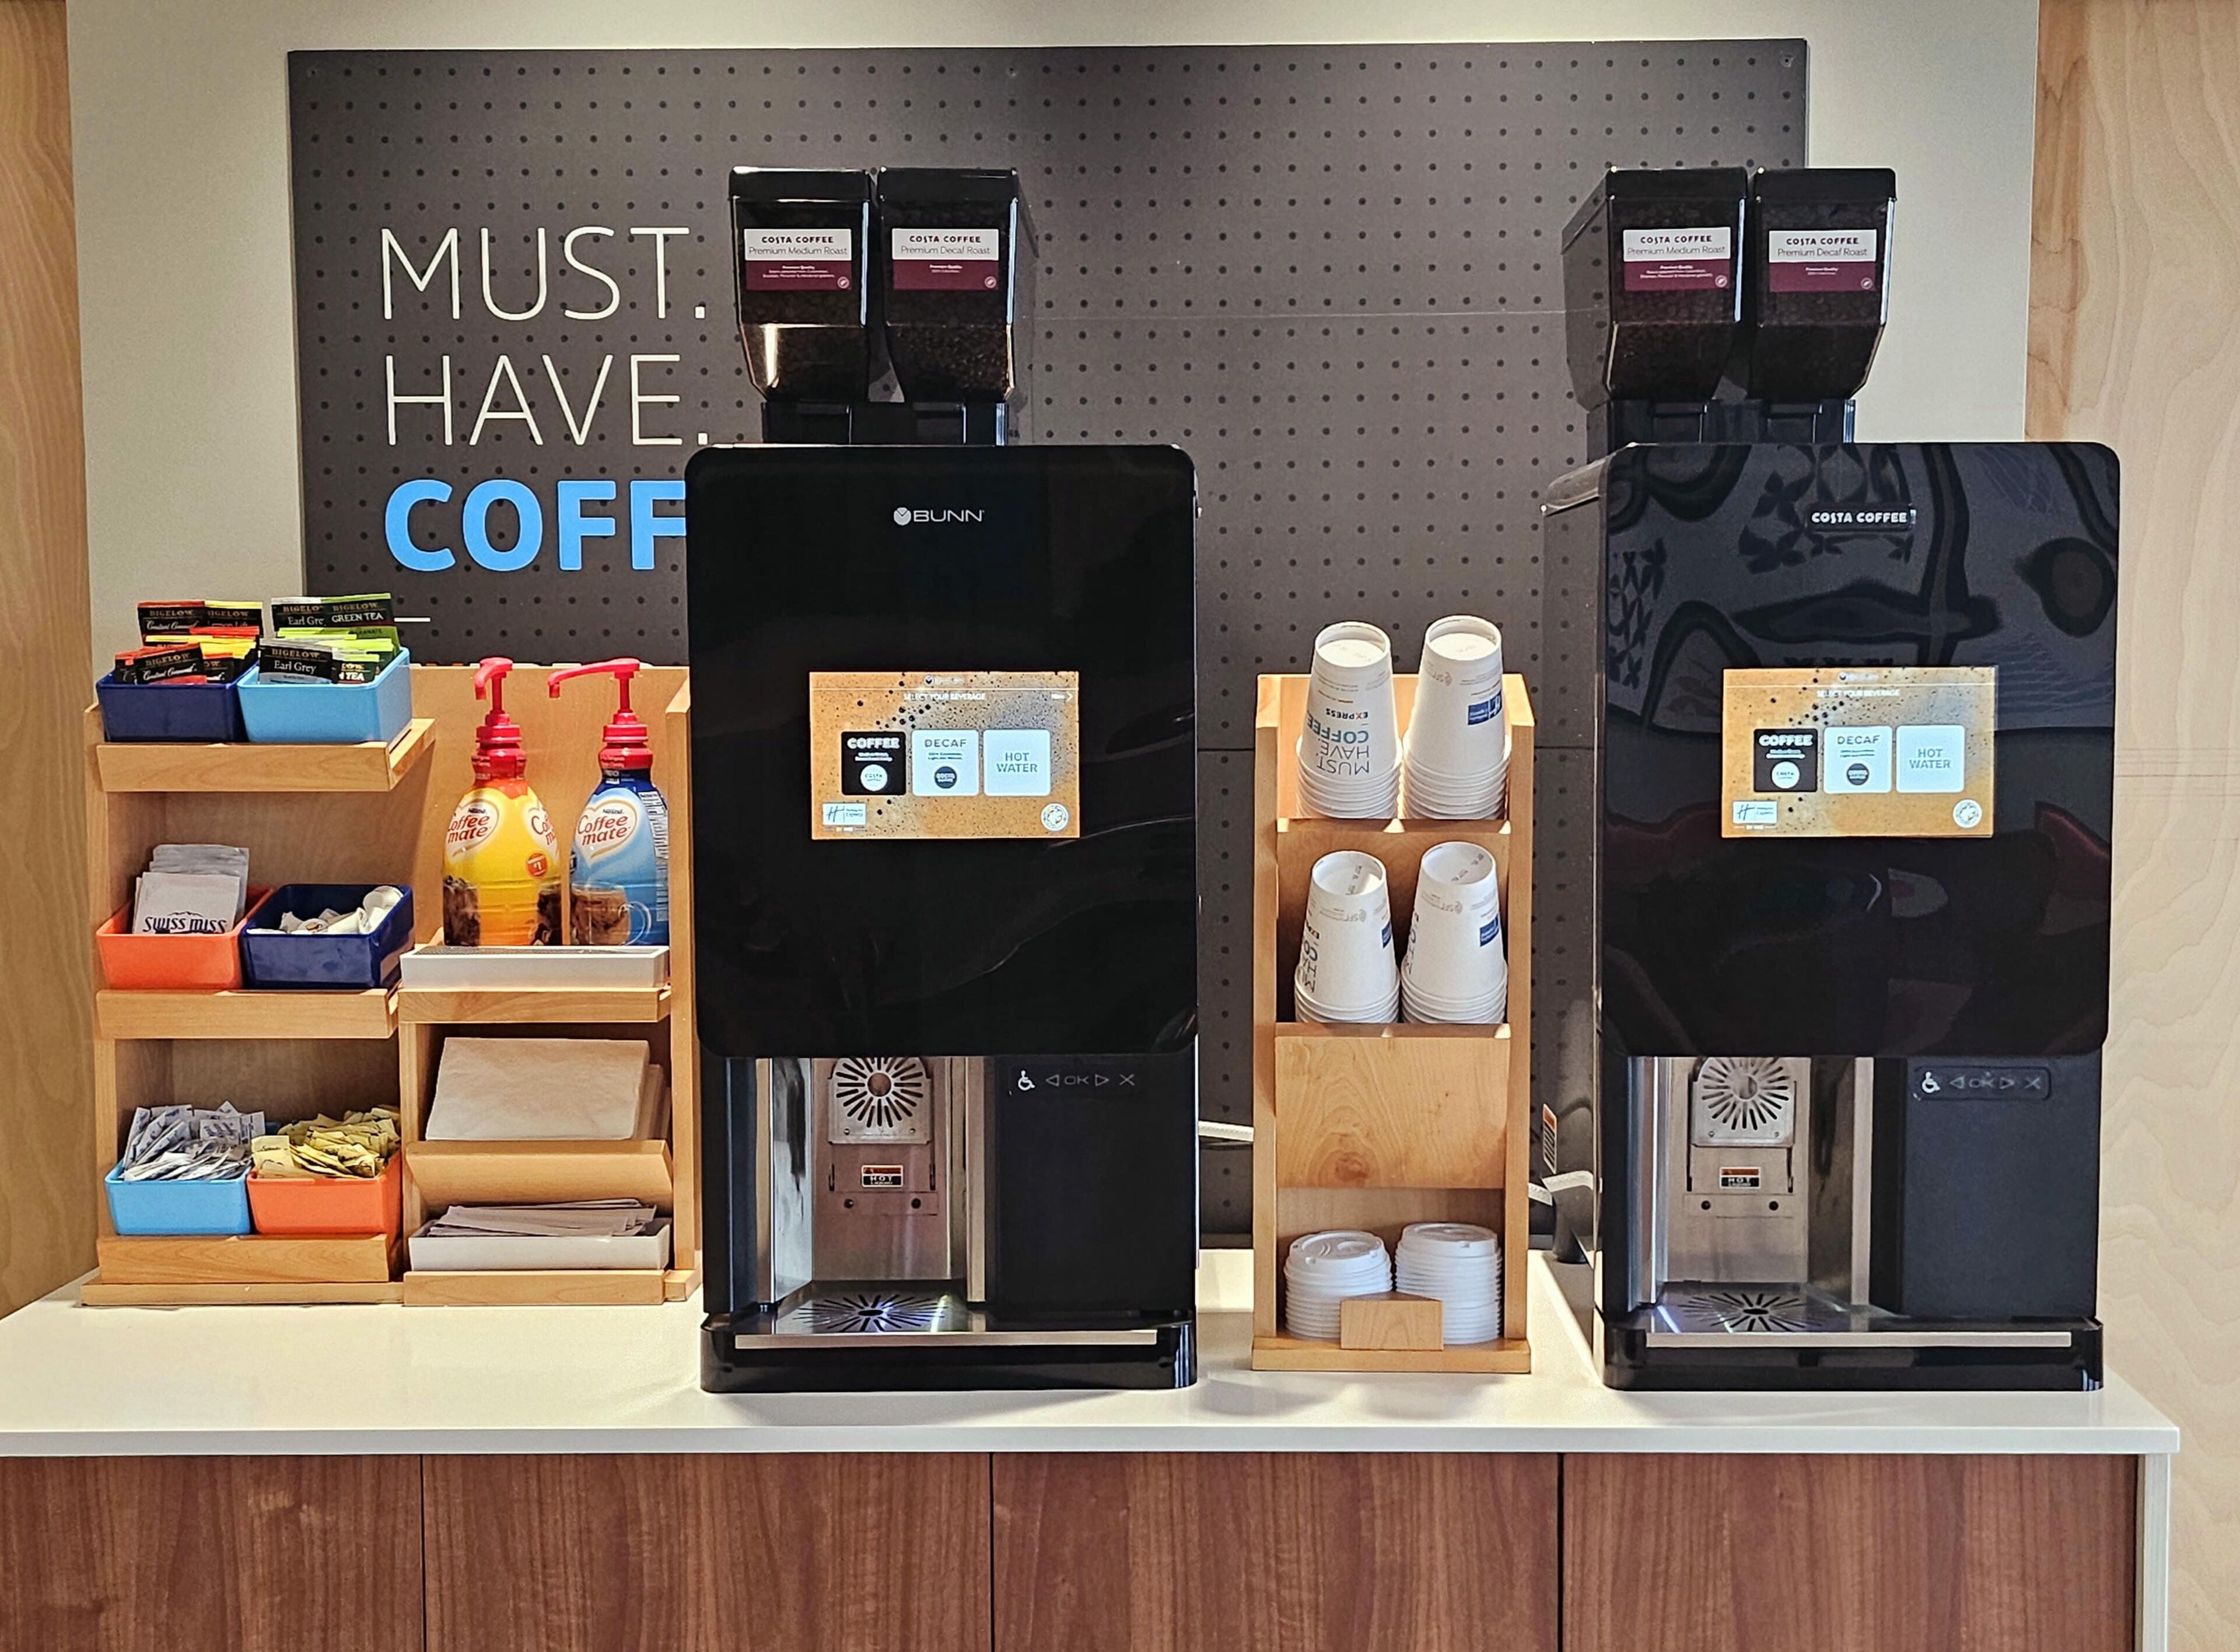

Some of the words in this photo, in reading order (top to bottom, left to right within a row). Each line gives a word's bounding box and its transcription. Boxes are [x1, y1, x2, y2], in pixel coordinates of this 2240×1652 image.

[1674, 235, 1712, 243] COFFEE
[749, 246, 786, 255] Premium
[788, 246, 822, 255] Medium
[824, 246, 848, 255] Roast
[901, 246, 939, 254] Premium
[967, 246, 991, 255] Roast
[1628, 247, 1664, 256] Premium
[1667, 247, 1700, 255] Medium
[1702, 246, 1725, 254] Roast
[1778, 249, 1815, 257] Premium
[1817, 247, 1842, 257] Decaf
[1844, 248, 1867, 256] Roast
[382, 226, 705, 320] MUST.
[386, 355, 708, 445] HAVE.
[914, 509, 982, 522] BUNN
[1811, 512, 1853, 524] COSTA
[1856, 512, 1908, 523] COFFEE
[332, 602, 379, 612] BIGELOW
[288, 616, 305, 625] Earl
[307, 617, 326, 626] Gre
[331, 614, 363, 623] GREEN
[364, 612, 384, 621] TEA
[272, 648, 320, 659] BIGELOW
[146, 653, 191, 666] BIGELOW
[274, 661, 292, 670] Earl
[294, 662, 316, 675] Grey
[1326, 708, 1368, 720] EXPRESS
[847, 737, 900, 749] COFFEE
[925, 738, 967, 747] DECAF
[1759, 734, 1813, 746] COFFEE
[1838, 734, 1880, 744] DECAF
[1005, 752, 1030, 761] HOT
[1917, 748, 1943, 758] HOT
[996, 763, 1038, 772] WATER
[1909, 760, 1951, 769] WATER
[578, 815, 628, 835] Coffee
[448, 825, 489, 845] mate
[582, 826, 628, 846] mate
[1065, 1076, 1089, 1085] OK
